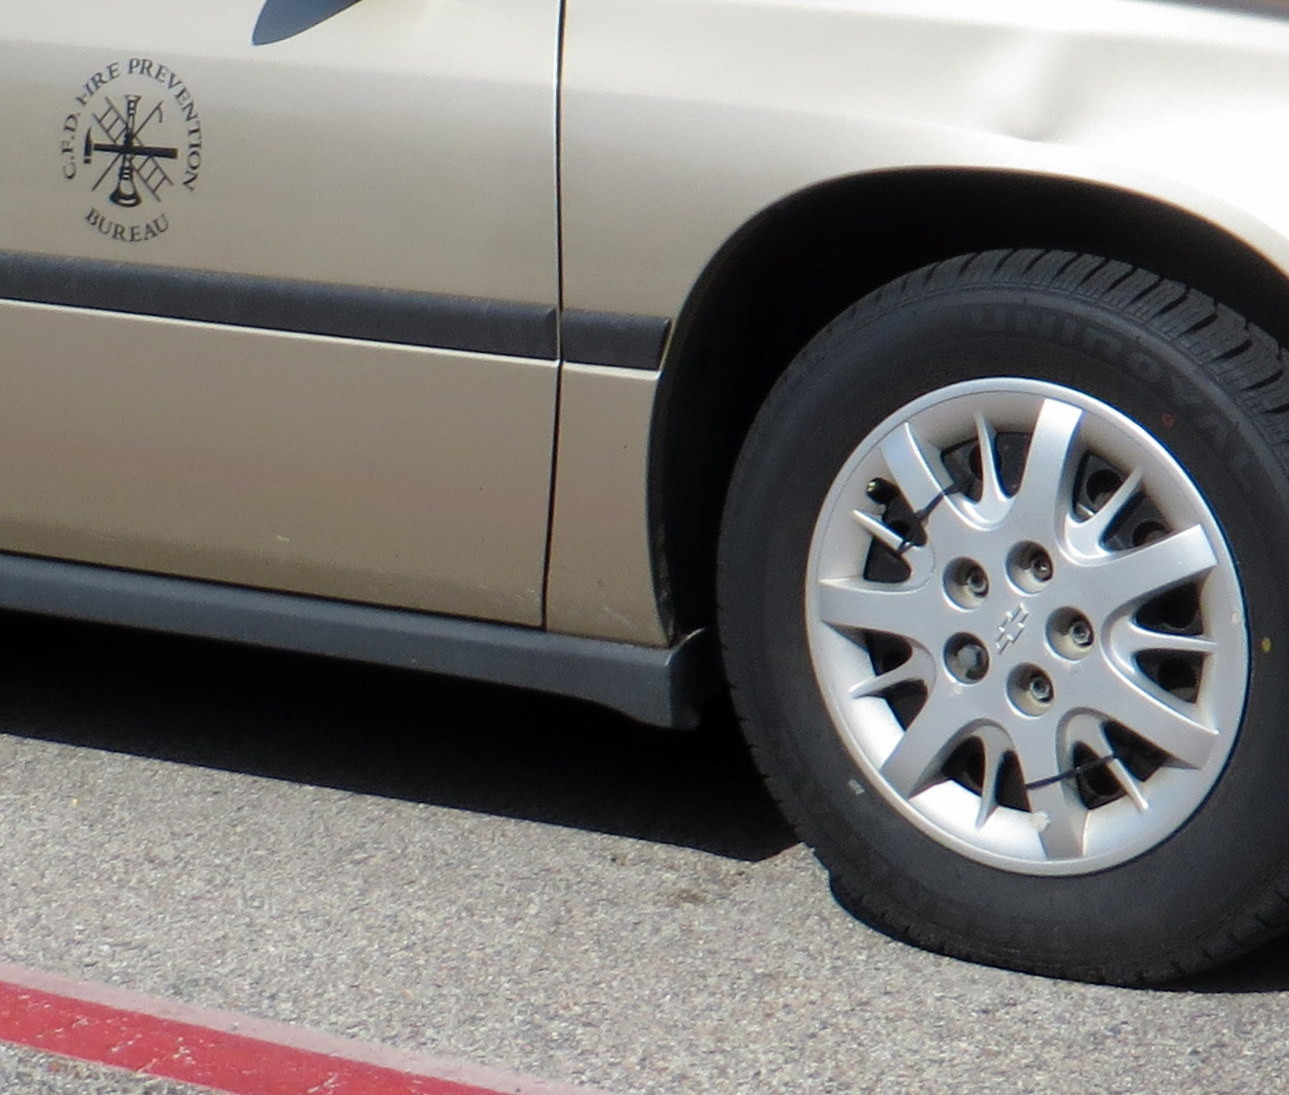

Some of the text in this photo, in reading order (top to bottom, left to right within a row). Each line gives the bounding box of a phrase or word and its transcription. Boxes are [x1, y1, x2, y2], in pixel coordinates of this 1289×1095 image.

[75, 62, 121, 107] FIRE
[127, 57, 203, 192] PREVENTION
[84, 207, 170, 243] BUREAU
